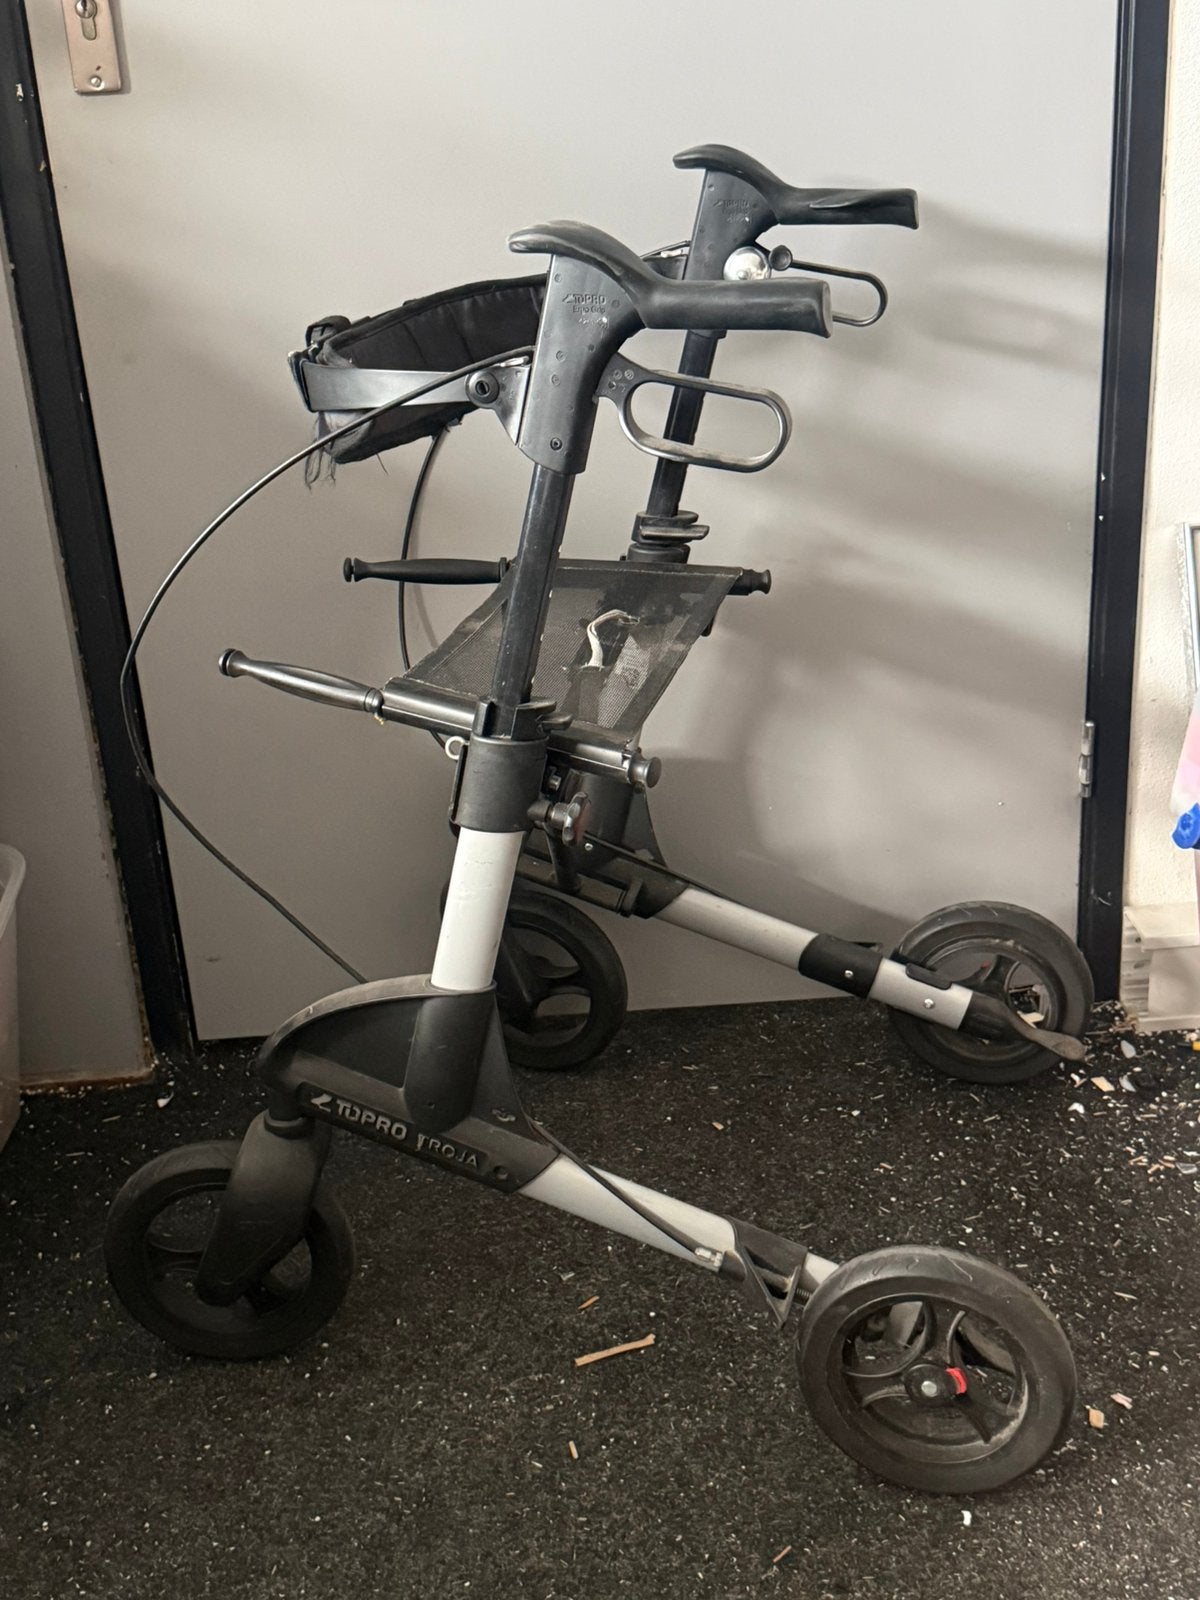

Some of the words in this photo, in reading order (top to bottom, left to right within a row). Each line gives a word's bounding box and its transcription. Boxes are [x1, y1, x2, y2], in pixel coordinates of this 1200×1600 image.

[572, 294, 606, 305] TOPRO
[336, 1099, 408, 1141] TOPRO
[417, 1133, 479, 1168] TROJA
